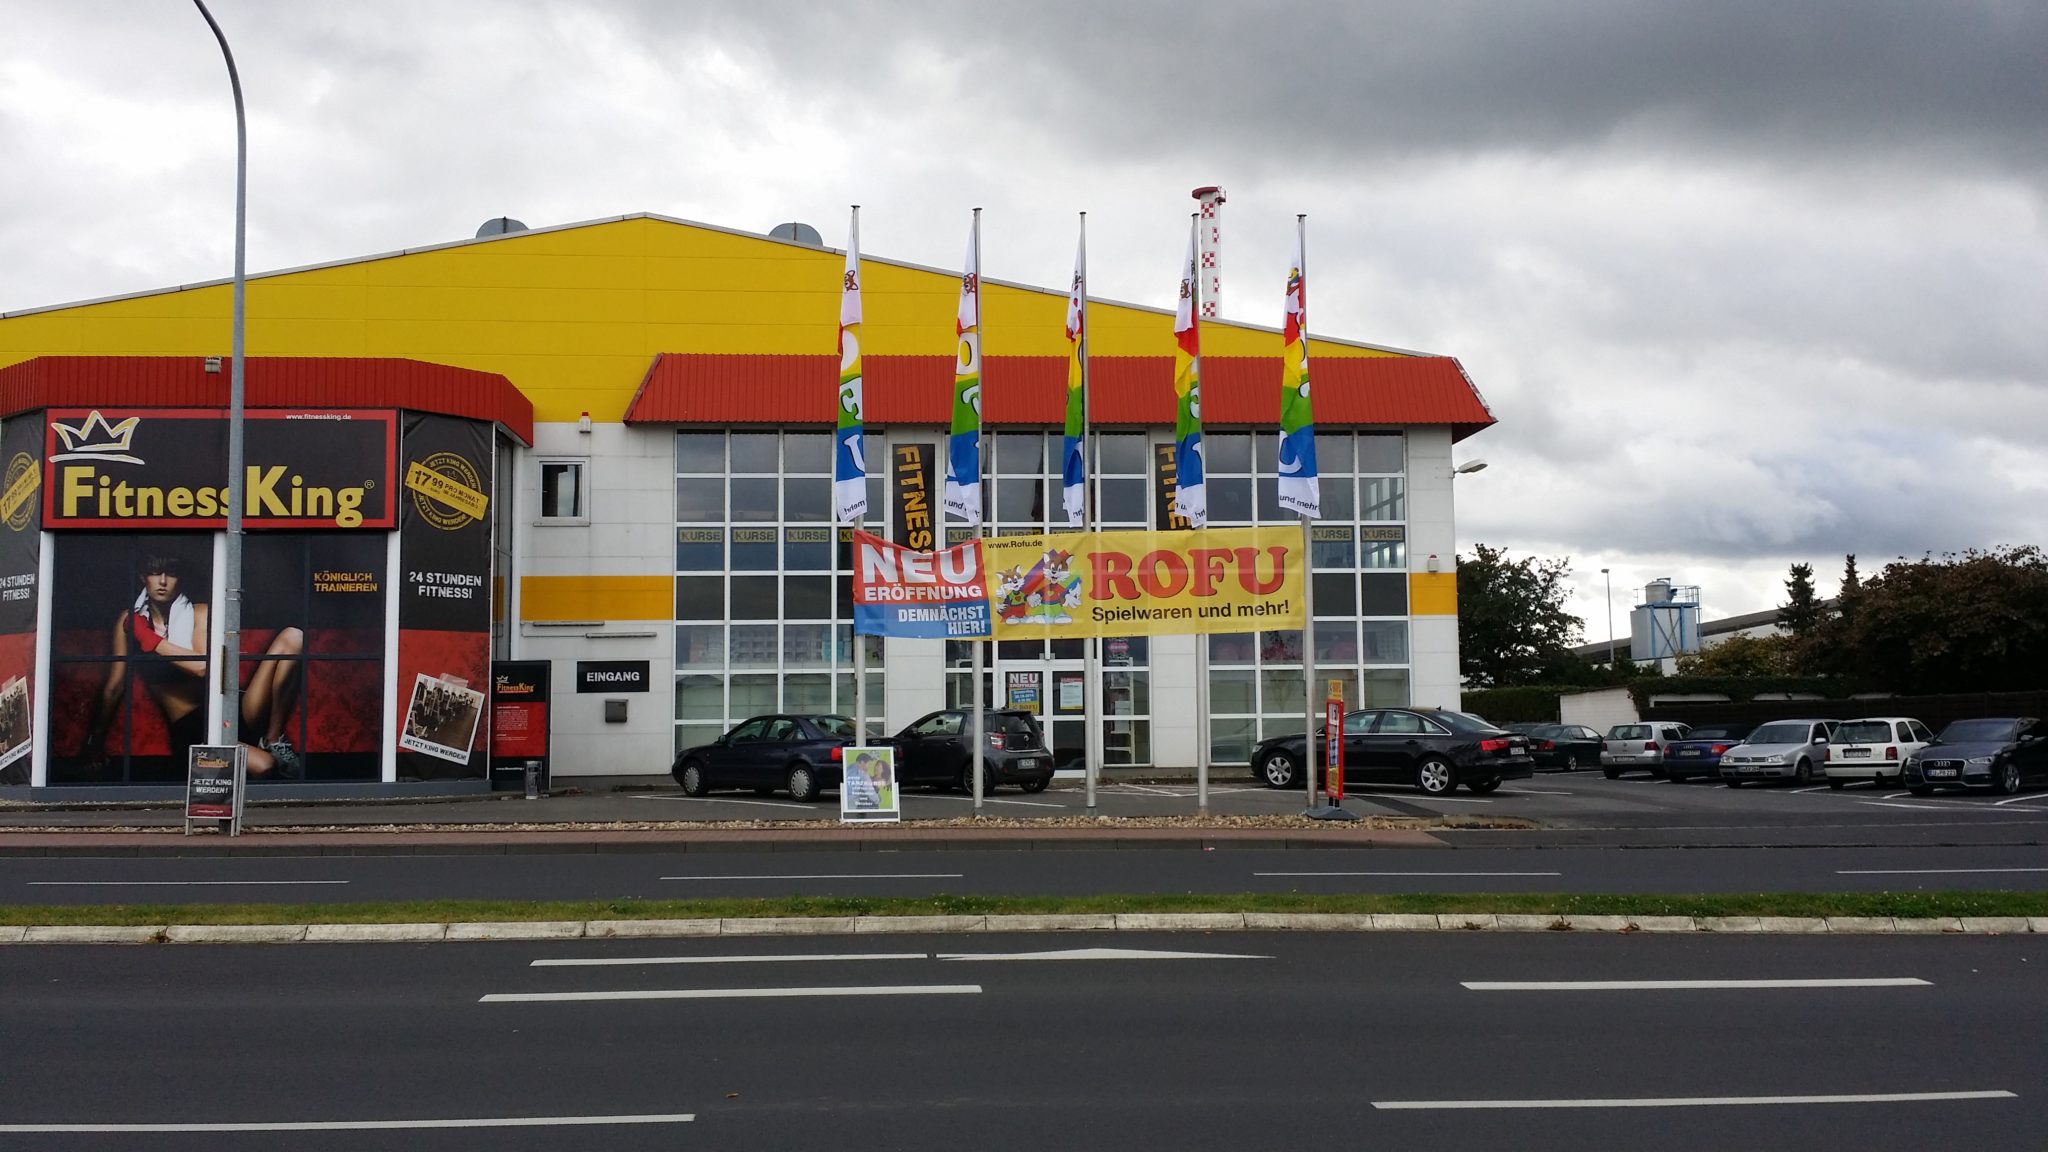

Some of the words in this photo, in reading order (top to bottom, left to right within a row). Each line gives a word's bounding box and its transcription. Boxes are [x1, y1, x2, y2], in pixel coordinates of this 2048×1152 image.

[286, 414, 352, 422] www.fitnessking.de
[896, 446, 932, 553] FITNES
[948, 500, 964, 510] und
[1280, 495, 1295, 503] und
[681, 532, 721, 541] KURSE
[735, 532, 774, 541] KURSE
[788, 532, 828, 540] KURSE
[1312, 530, 1350, 539] KURSE
[1364, 530, 1401, 538] KURSE
[988, 539, 1043, 549] www.Rofu.de
[861, 544, 977, 584] NEU
[314, 570, 372, 582] KÖNIGLICH
[409, 572, 424, 583] 24
[426, 572, 482, 586] STUNDEN
[1087, 546, 1289, 600] ROFU
[7, 573, 35, 587] STUNDEN
[314, 583, 378, 592] TRAINIEREN
[418, 586, 472, 599] FITNESS!
[864, 584, 982, 601] ERÖFFNUNG
[3, 588, 30, 601] FITNESS!
[898, 605, 985, 622] DEMNÄCHST
[1092, 606, 1192, 623] Spielwaren
[1198, 602, 1231, 618] und
[1237, 600, 1290, 616] mehr!
[948, 621, 986, 635] HIER!
[587, 672, 640, 682] EINGANG
[1010, 673, 1038, 684] NEU
[404, 738, 424, 749] JETZT
[424, 744, 439, 753] KING
